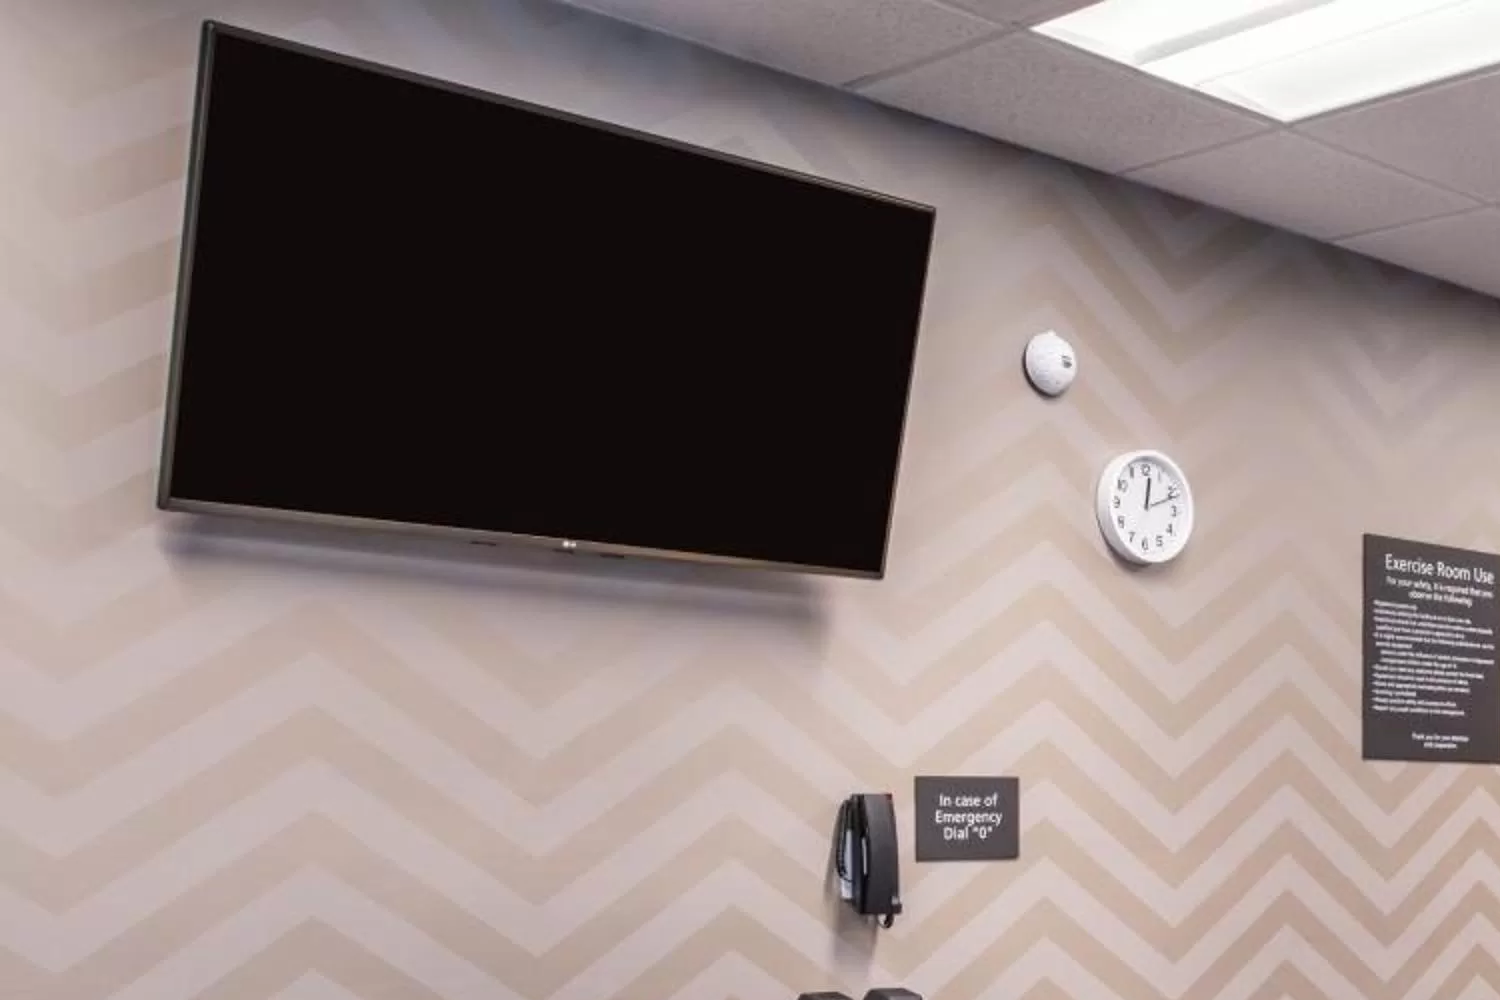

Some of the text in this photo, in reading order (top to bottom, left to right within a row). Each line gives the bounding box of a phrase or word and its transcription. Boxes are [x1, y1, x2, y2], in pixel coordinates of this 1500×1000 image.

[1385, 553, 1496, 585] Exercise Room Use
[939, 792, 998, 807] In case of
[935, 809, 1003, 827] Emergency
[943, 825, 969, 840] Dial
